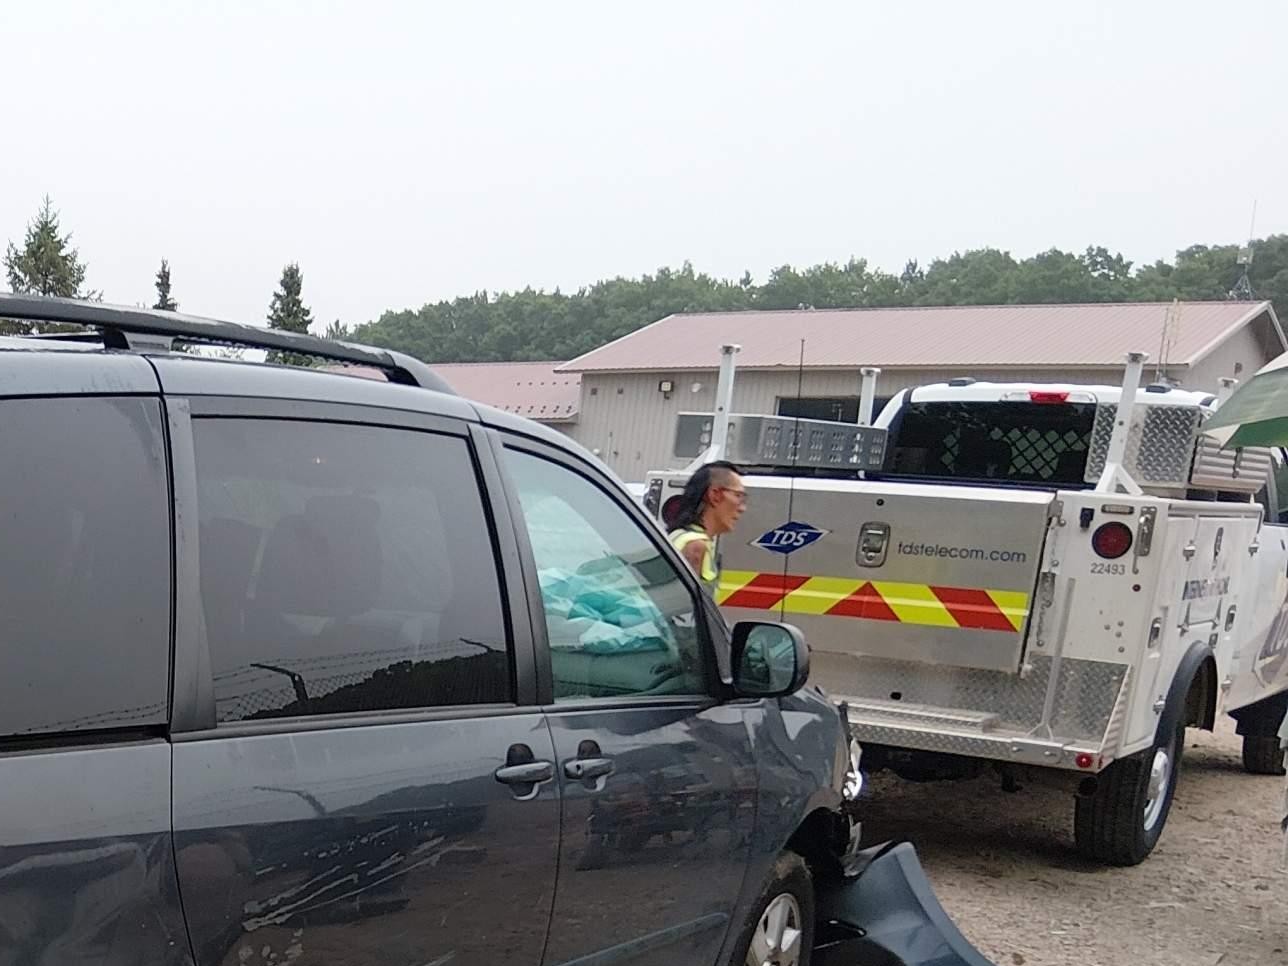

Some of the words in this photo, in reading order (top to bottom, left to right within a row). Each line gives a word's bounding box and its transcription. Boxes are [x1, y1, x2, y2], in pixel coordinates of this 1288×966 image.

[772, 530, 809, 546] TDS
[897, 541, 1027, 562] tdstelecom.com
[1090, 562, 1126, 576] 22493
